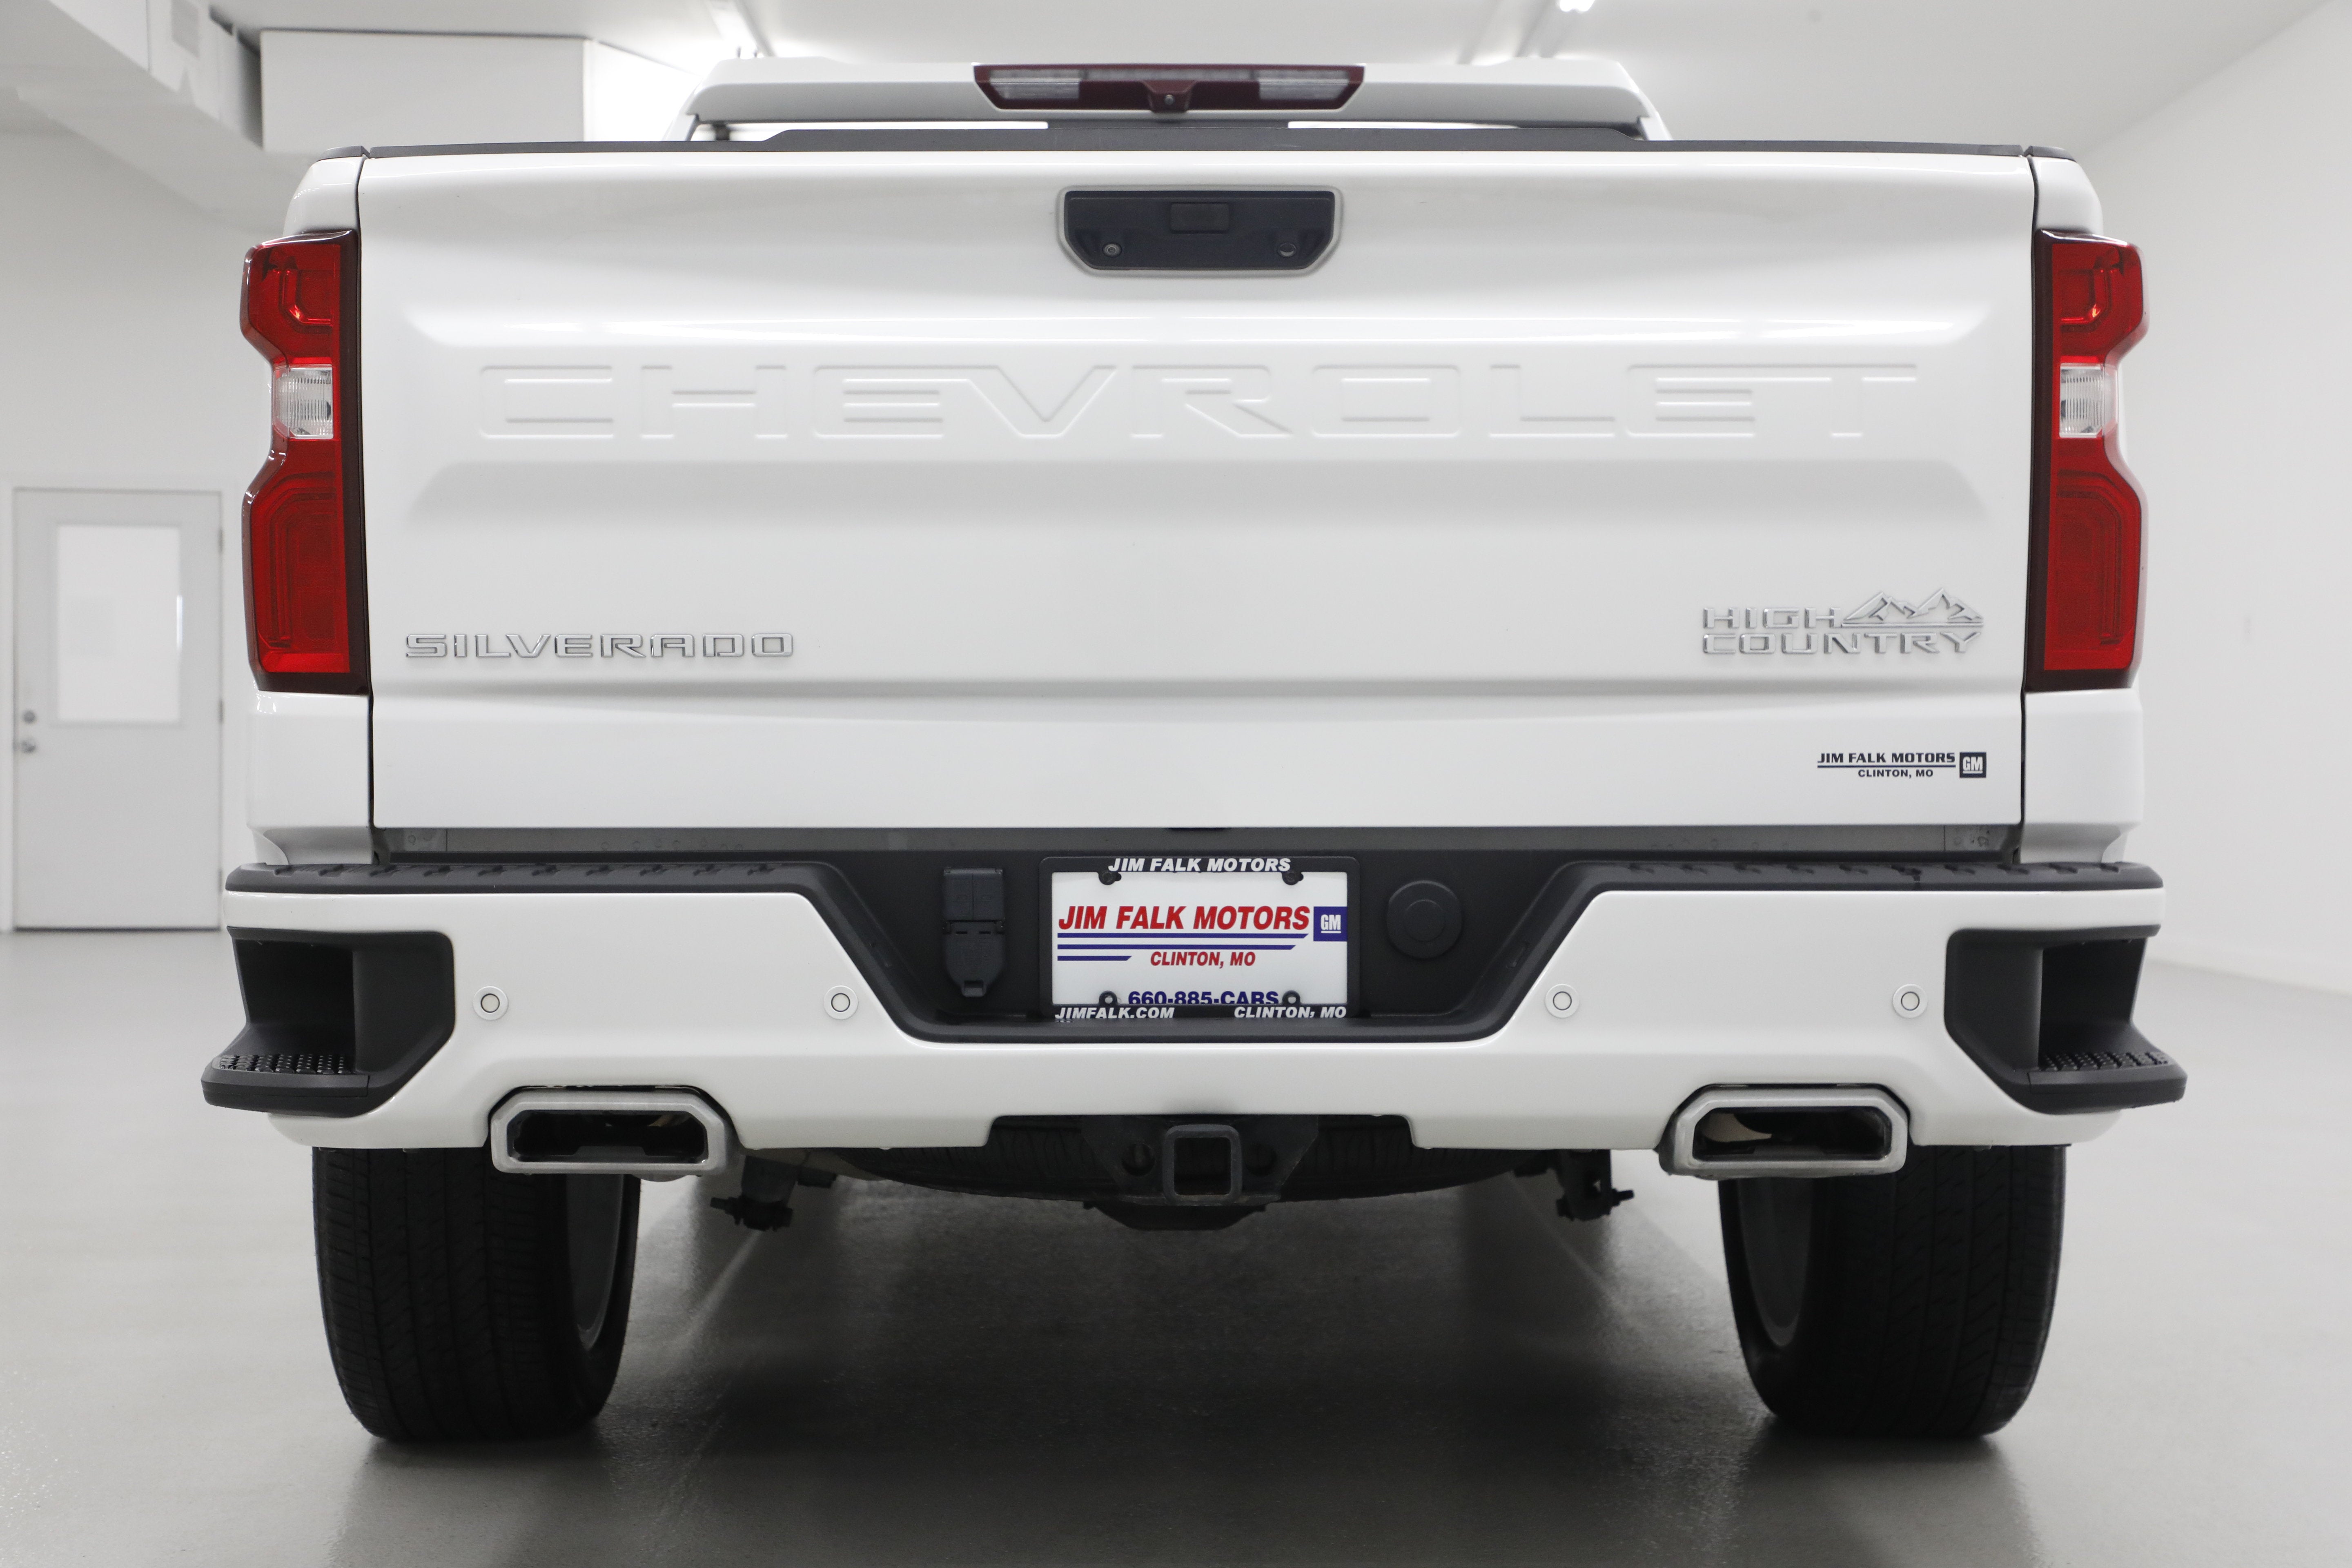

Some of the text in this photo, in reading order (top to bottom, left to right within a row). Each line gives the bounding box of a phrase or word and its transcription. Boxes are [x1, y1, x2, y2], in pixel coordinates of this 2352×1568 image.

[479, 363, 1918, 439] CHEVROLET
[1703, 608, 1841, 628] HIGH
[405, 634, 794, 658] SILVERADO
[1702, 633, 1981, 654] COUNTRY
[1818, 753, 1956, 764] JIM FALK MOTORS
[1963, 756, 1983, 771] GM
[1858, 769, 1934, 779] CLINTON, MO
[1108, 858, 1291, 872] JIM FALK MOTORS
[1059, 906, 1310, 930] JIM FALK MOTORS
[1321, 914, 1341, 931] GM
[1151, 951, 1256, 968] CLINTON, MO
[1128, 991, 1279, 1004] 660-885-CARS
[1055, 1007, 1175, 1020] JIMFALK.COM
[1235, 1006, 1347, 1018] CLINTON, MO
